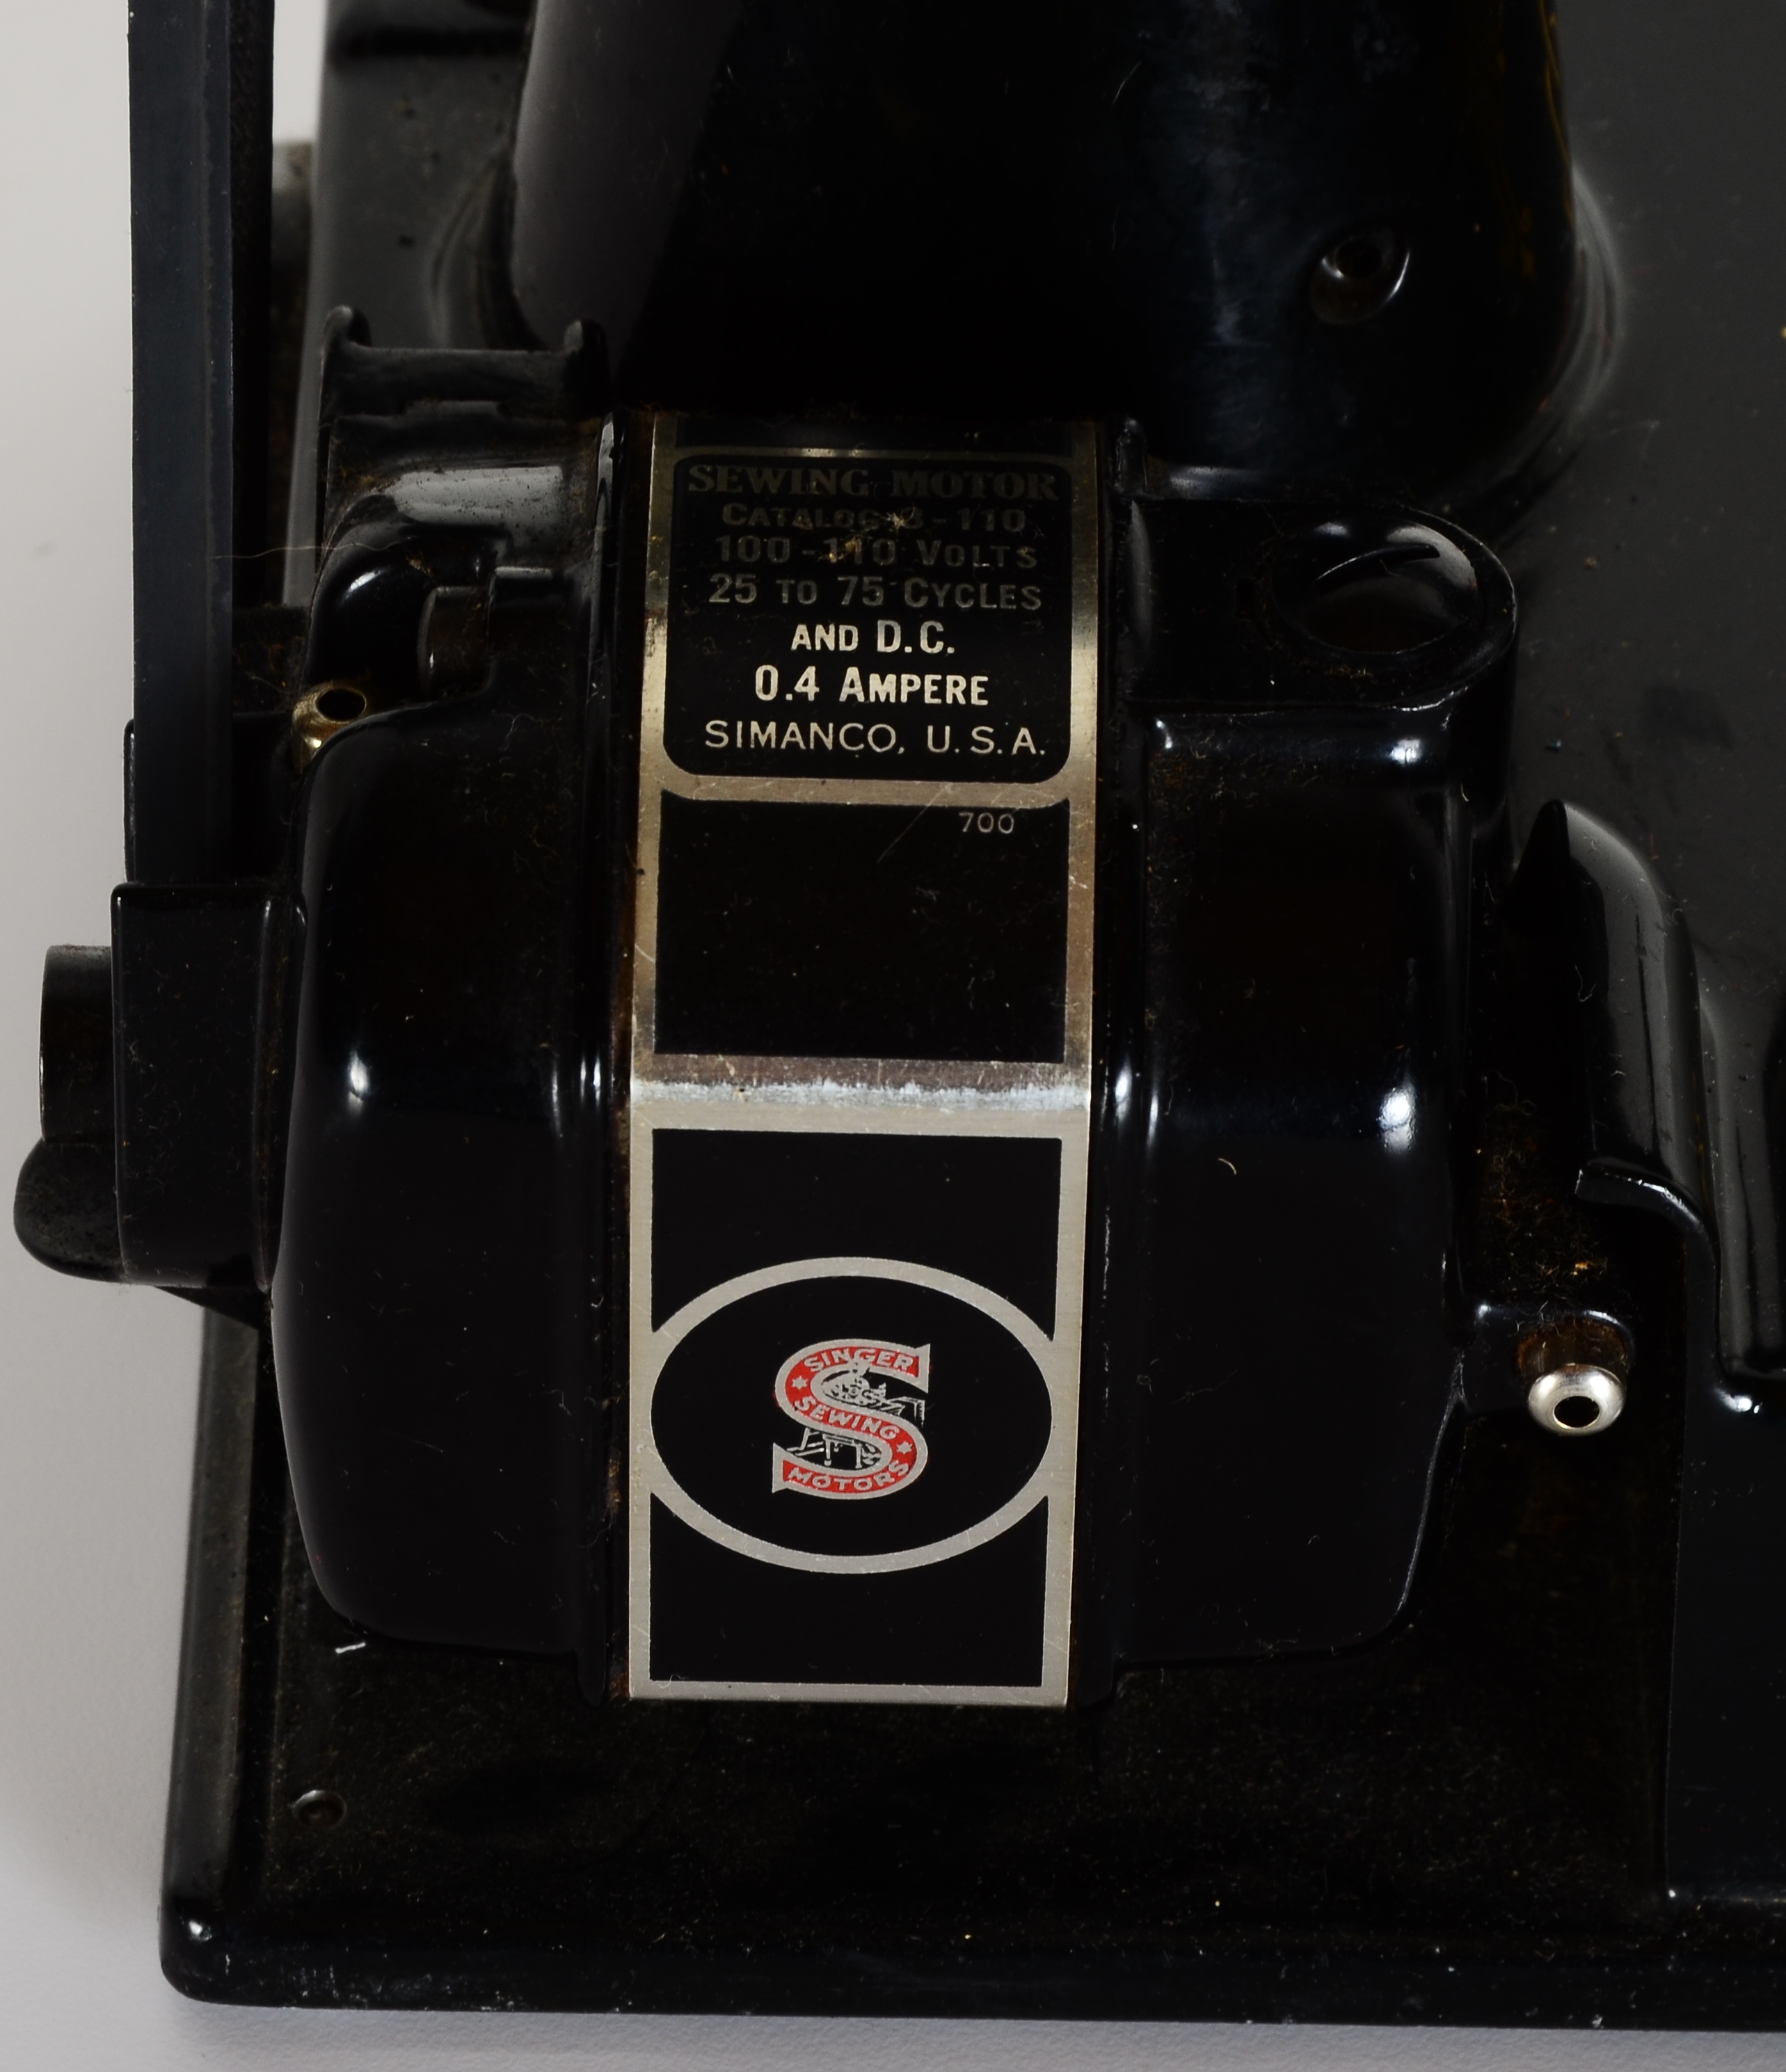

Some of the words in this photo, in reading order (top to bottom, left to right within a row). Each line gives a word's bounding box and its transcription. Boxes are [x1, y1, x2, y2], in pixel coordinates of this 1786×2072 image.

[689, 464, 869, 497] SEWING
[891, 469, 1059, 501] MOTOR
[722, 502, 882, 532] CATALOG
[915, 539, 1038, 570] VOLTS
[708, 573, 758, 604] 25
[776, 579, 818, 605] TO
[836, 576, 885, 607] 75
[904, 577, 1042, 611] CYCLES
[790, 624, 859, 651] AND
[877, 620, 955, 654] D.C.
[755, 664, 820, 701] 0.4
[839, 667, 989, 706] AMPERE
[959, 811, 1015, 834] 700
[804, 1348, 914, 1373] SINGER
[794, 1396, 900, 1440] SEWING
[788, 1459, 909, 1491] MOTORS
